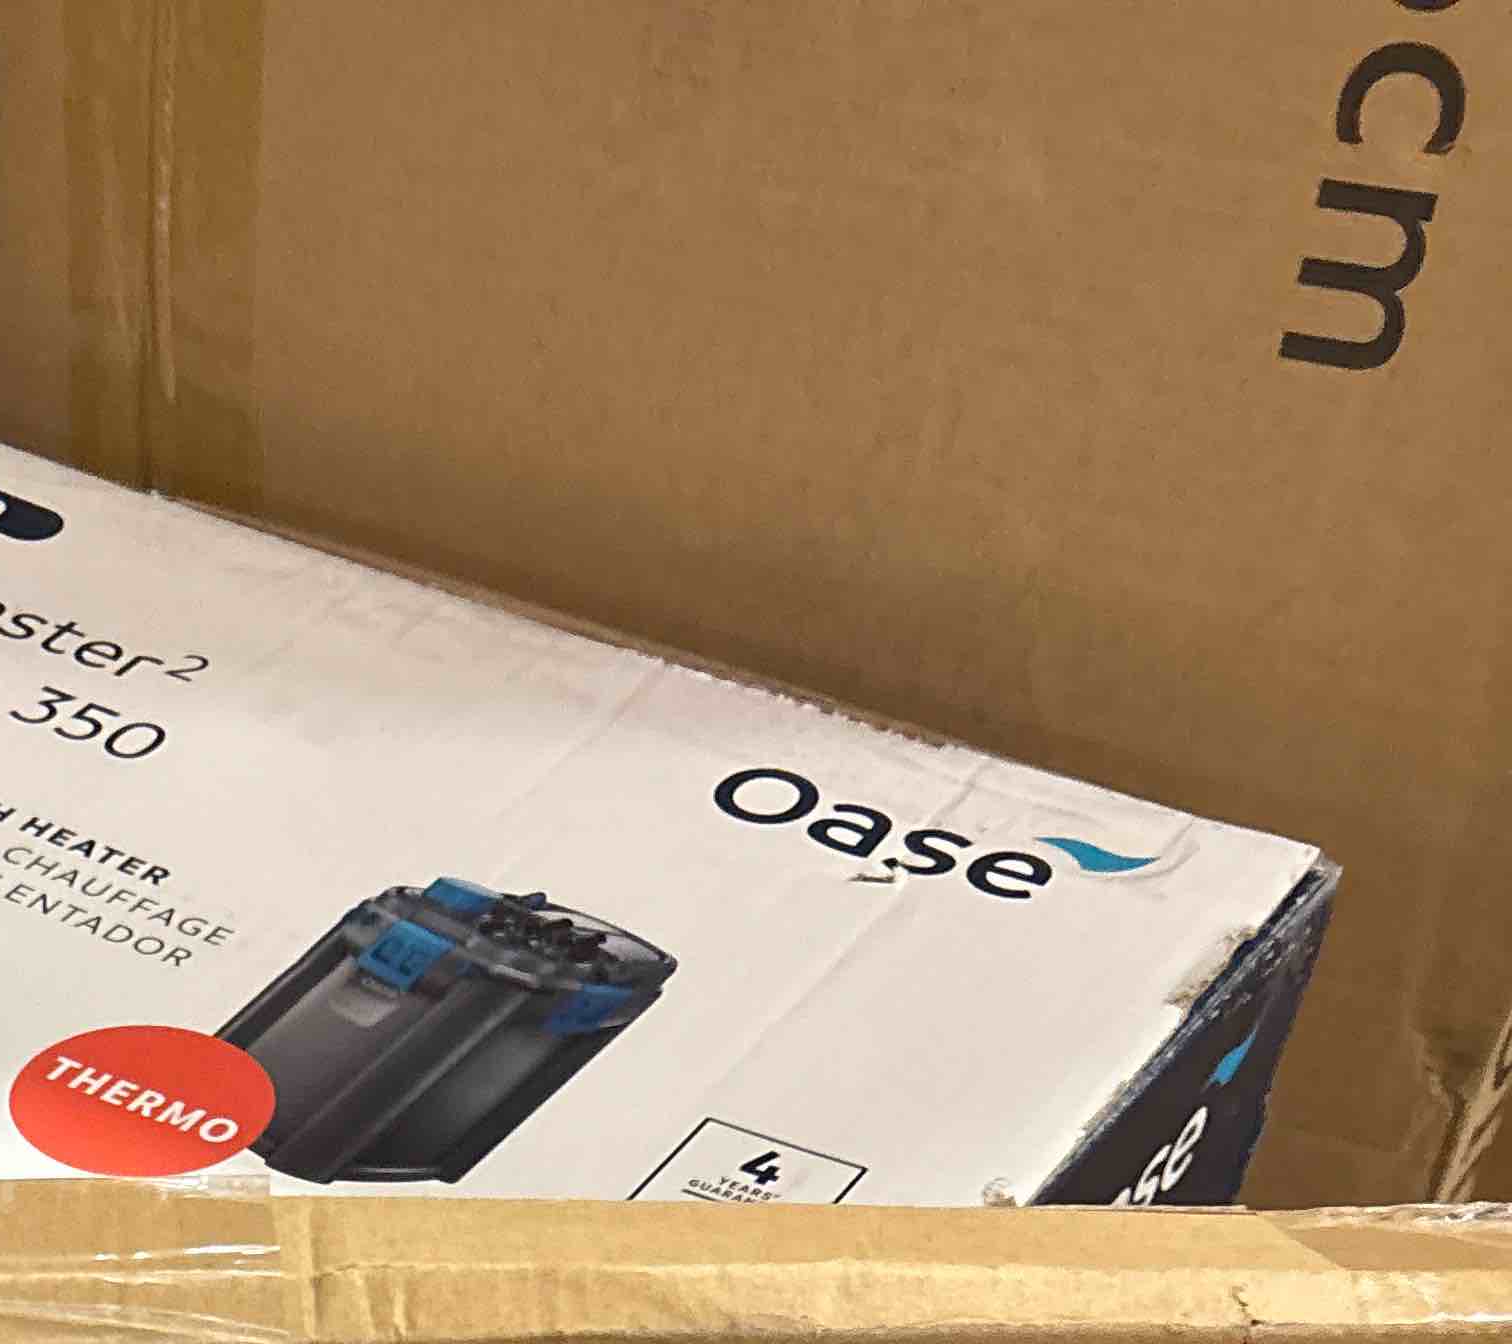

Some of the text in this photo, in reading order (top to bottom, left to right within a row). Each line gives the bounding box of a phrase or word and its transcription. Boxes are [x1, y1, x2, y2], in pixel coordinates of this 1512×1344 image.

[1278, 0, 1467, 370] cm
[10, 686, 168, 761] 350
[20, 816, 171, 887] HEATER
[712, 767, 1053, 900] Oase
[2, 846, 235, 947] CHAUFFAGE
[44, 1055, 239, 1144] THERMO
[739, 1150, 780, 1185] 4
